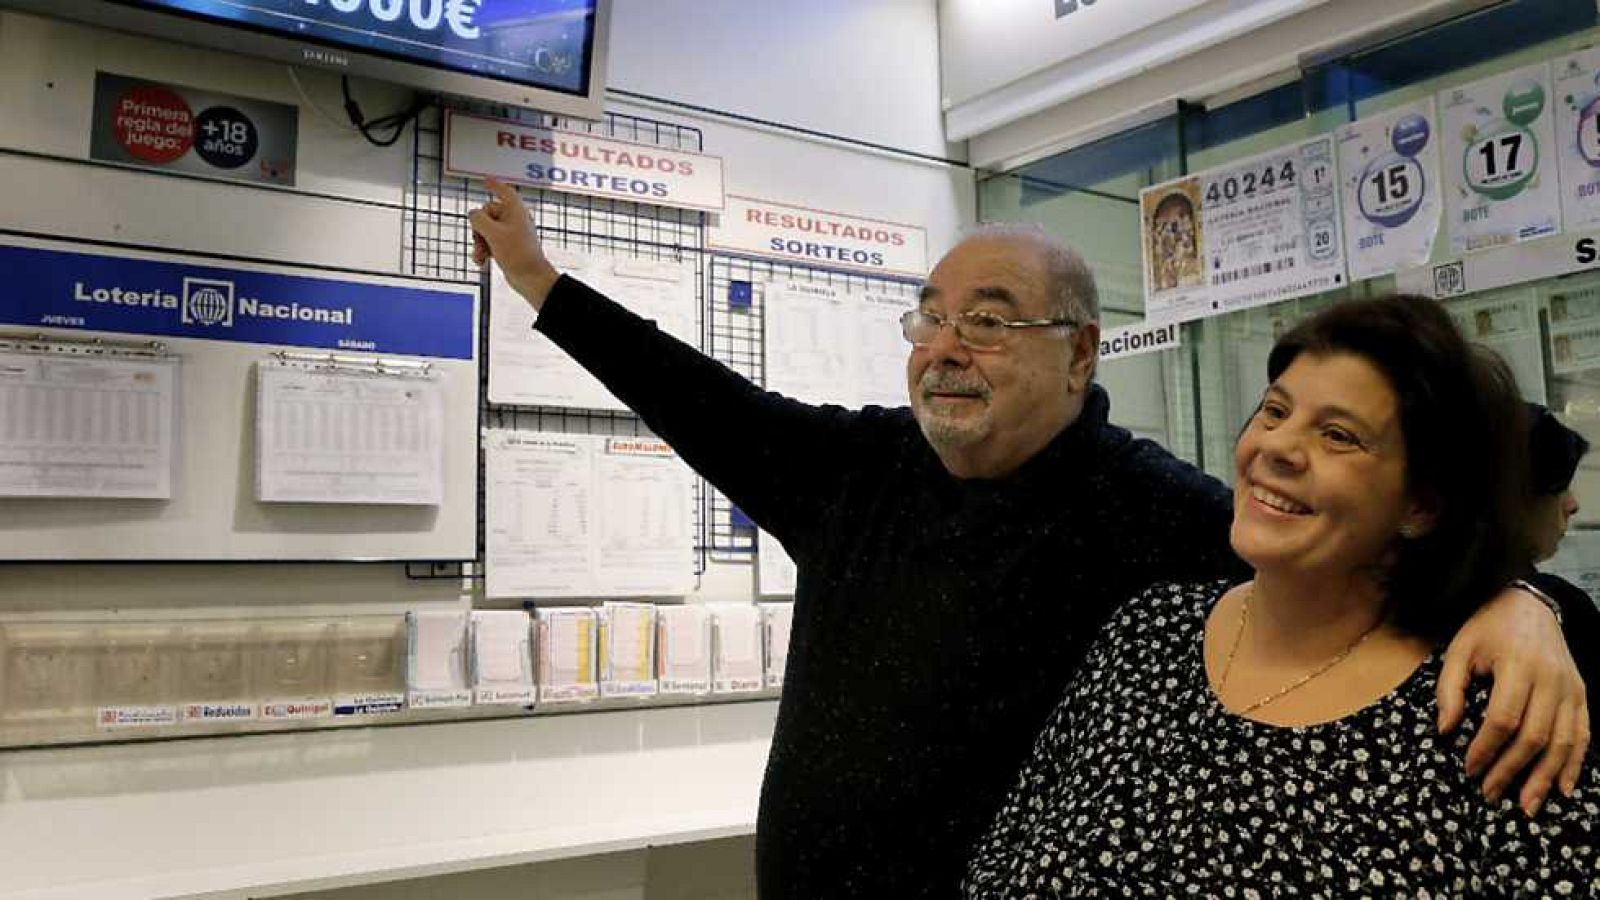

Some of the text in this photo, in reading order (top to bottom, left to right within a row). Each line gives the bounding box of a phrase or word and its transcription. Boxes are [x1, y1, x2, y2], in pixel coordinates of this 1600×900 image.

[122, 99, 189, 123] Primera
[117, 115, 192, 138] regla del
[202, 119, 248, 144] +18
[203, 139, 243, 157] años
[497, 131, 695, 175] RESULTADOS
[1479, 133, 1521, 176] 17
[526, 163, 669, 198] SORTEOS
[1206, 160, 1295, 201] 40244
[1371, 165, 1409, 203] 15
[745, 207, 906, 247] RESULTADOS
[1314, 231, 1330, 247] 20
[769, 237, 885, 267] SORTEOS
[238, 298, 353, 326] Nacional
